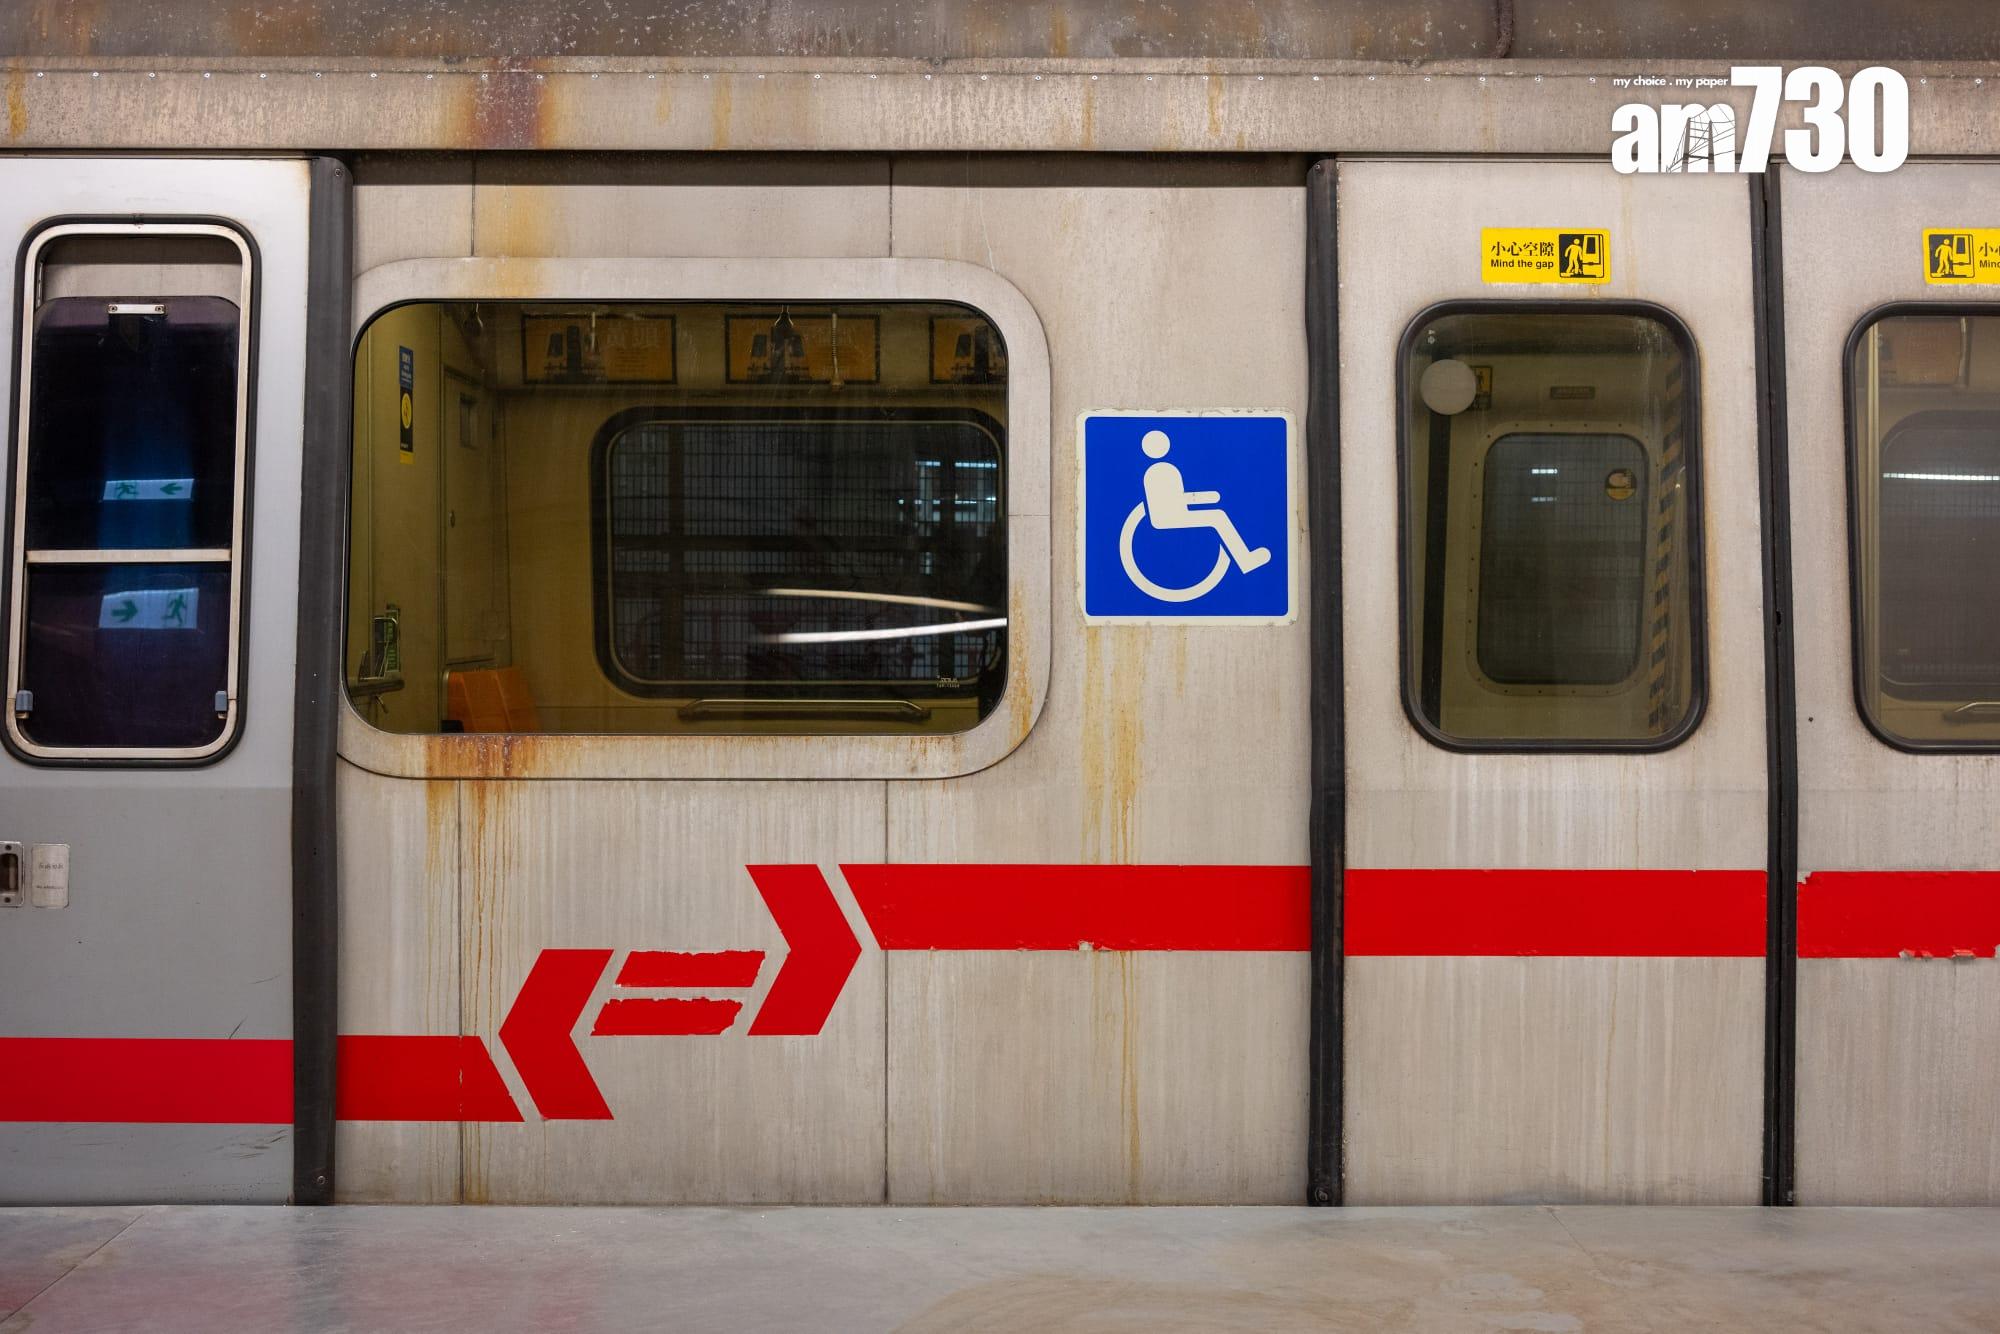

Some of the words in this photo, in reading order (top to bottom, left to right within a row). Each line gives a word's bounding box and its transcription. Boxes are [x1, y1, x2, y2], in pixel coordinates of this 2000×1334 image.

[1491, 241, 1554, 256] 小心空隙
[1491, 259, 1514, 268] Mind
[1518, 259, 1532, 268] the
[1536, 261, 1554, 269] gap
